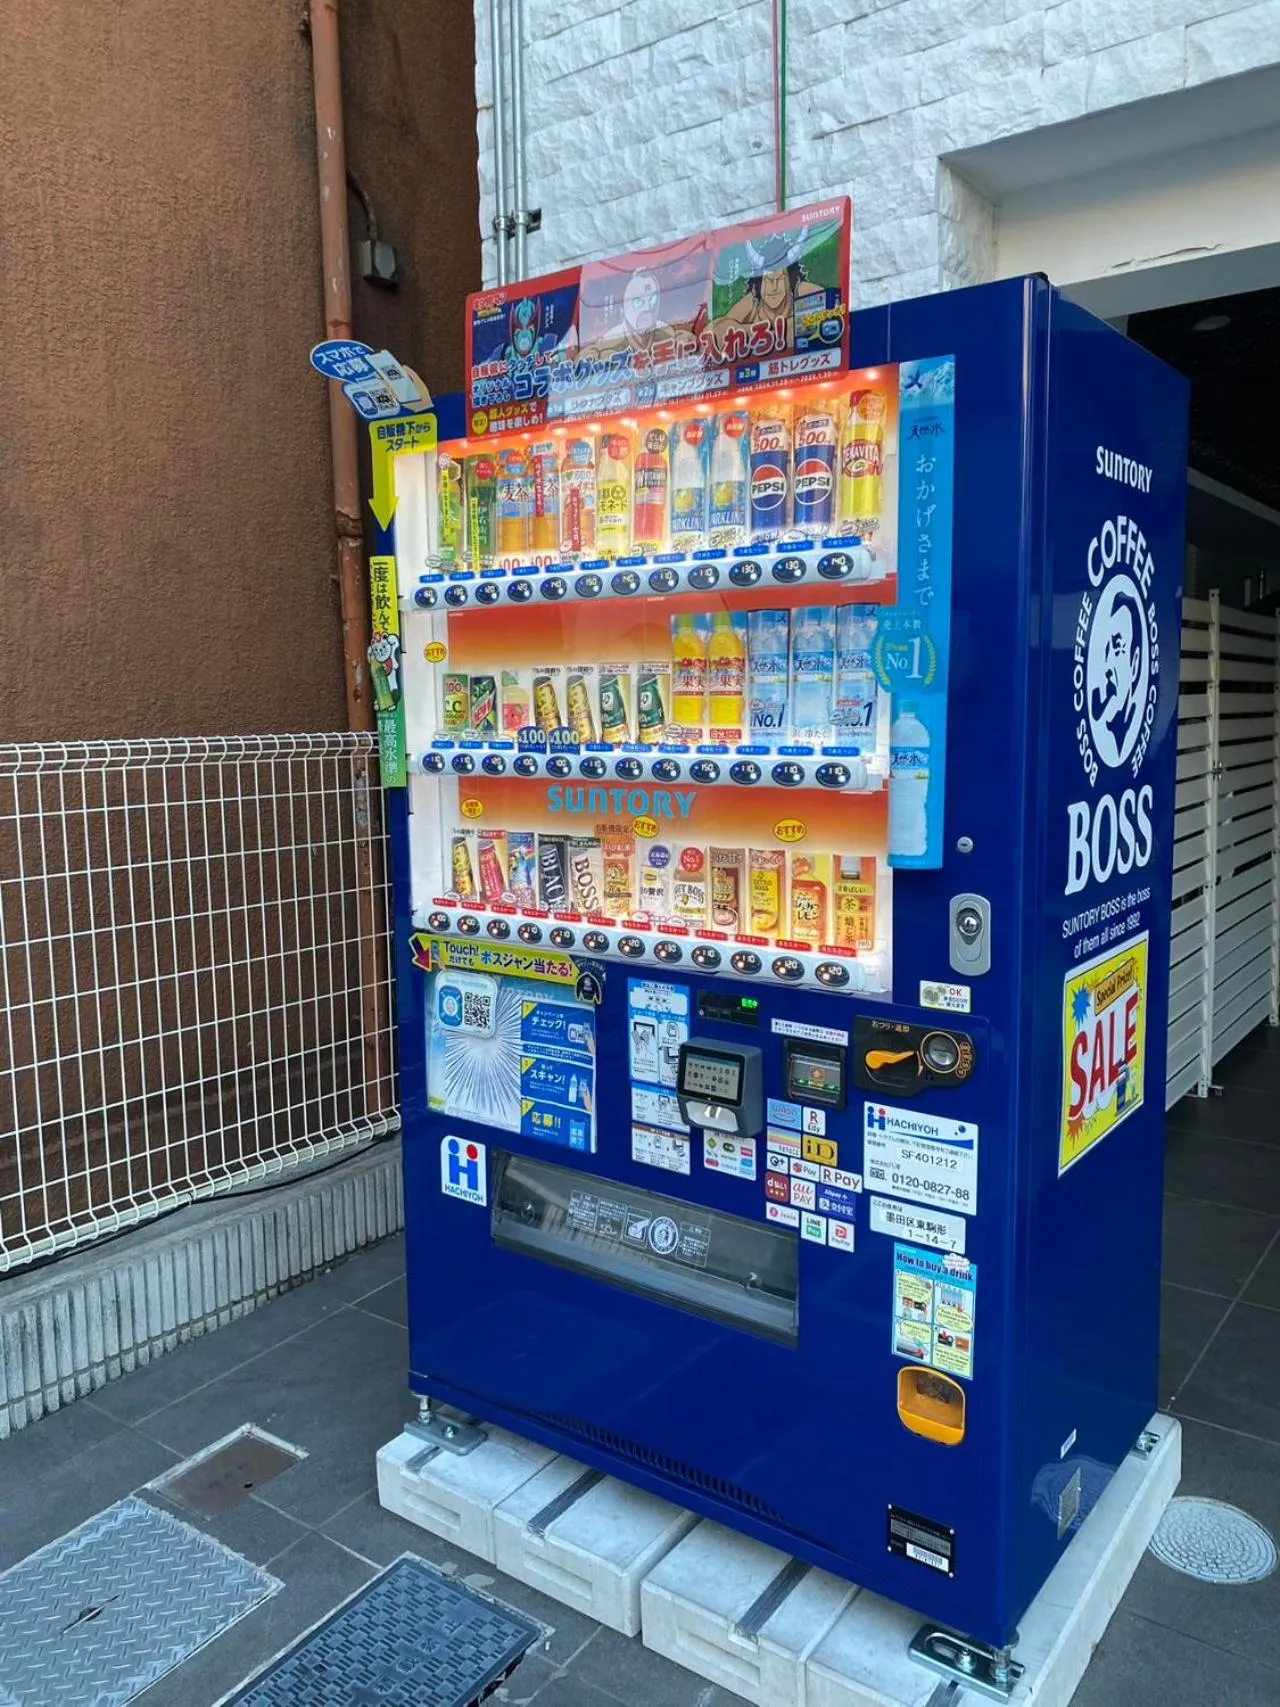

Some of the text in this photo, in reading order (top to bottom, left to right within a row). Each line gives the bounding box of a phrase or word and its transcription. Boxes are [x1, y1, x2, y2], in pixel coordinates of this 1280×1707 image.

[315, 345, 366, 365] スマホで
[767, 353, 832, 375] 筋トレグッズ
[377, 421, 432, 440] 自販機下から
[387, 438, 420, 453] スタート
[1095, 444, 1154, 494] SUNTORY
[503, 482, 528, 501] 麦茶
[751, 481, 785, 496] PEPSI
[794, 476, 831, 489] PEPSI
[913, 453, 937, 606] おかげさまで
[1087, 515, 1155, 599] COFFEE
[1073, 591, 1099, 788] BOSS COFFEE
[1130, 601, 1160, 779] BOSS COFFEE
[547, 784, 695, 820] SUNTORY
[774, 823, 804, 836] おすすめ
[1063, 783, 1154, 896] BOSS
[574, 857, 600, 909] BOSS
[1062, 902, 1101, 939] SUNTORY
[1100, 896, 1121, 921] BOSS
[1135, 886, 1151, 902] boss
[1073, 941, 1083, 959] of
[1081, 935, 1101, 954] them
[1108, 922, 1126, 940] since
[1125, 911, 1142, 931] 1992
[444, 941, 479, 957] Touch!
[481, 950, 574, 978] ボスジャン当たる!
[949, 988, 962, 996] OK
[1095, 979, 1118, 1009] Special
[531, 1015, 566, 1030] チェック!
[1068, 990, 1141, 1120] SALE
[530, 1069, 566, 1085] スキャン!
[886, 1117, 939, 1137] HACHIYOH
[806, 1139, 835, 1160] iD
[900, 1149, 958, 1170] SF401212
[823, 1168, 861, 1189] R Pay
[891, 1172, 971, 1201] 0120-0827-88
[444, 1183, 485, 1204] HACHIYOH
[793, 1192, 812, 1206] PAY
[806, 1217, 821, 1227] LINE
[886, 1211, 948, 1236] 墨田区東駒形
[896, 1252, 915, 1265] How
[916, 1257, 924, 1268] to
[925, 1260, 942, 1275] buy
[949, 1266, 973, 1282] drink
